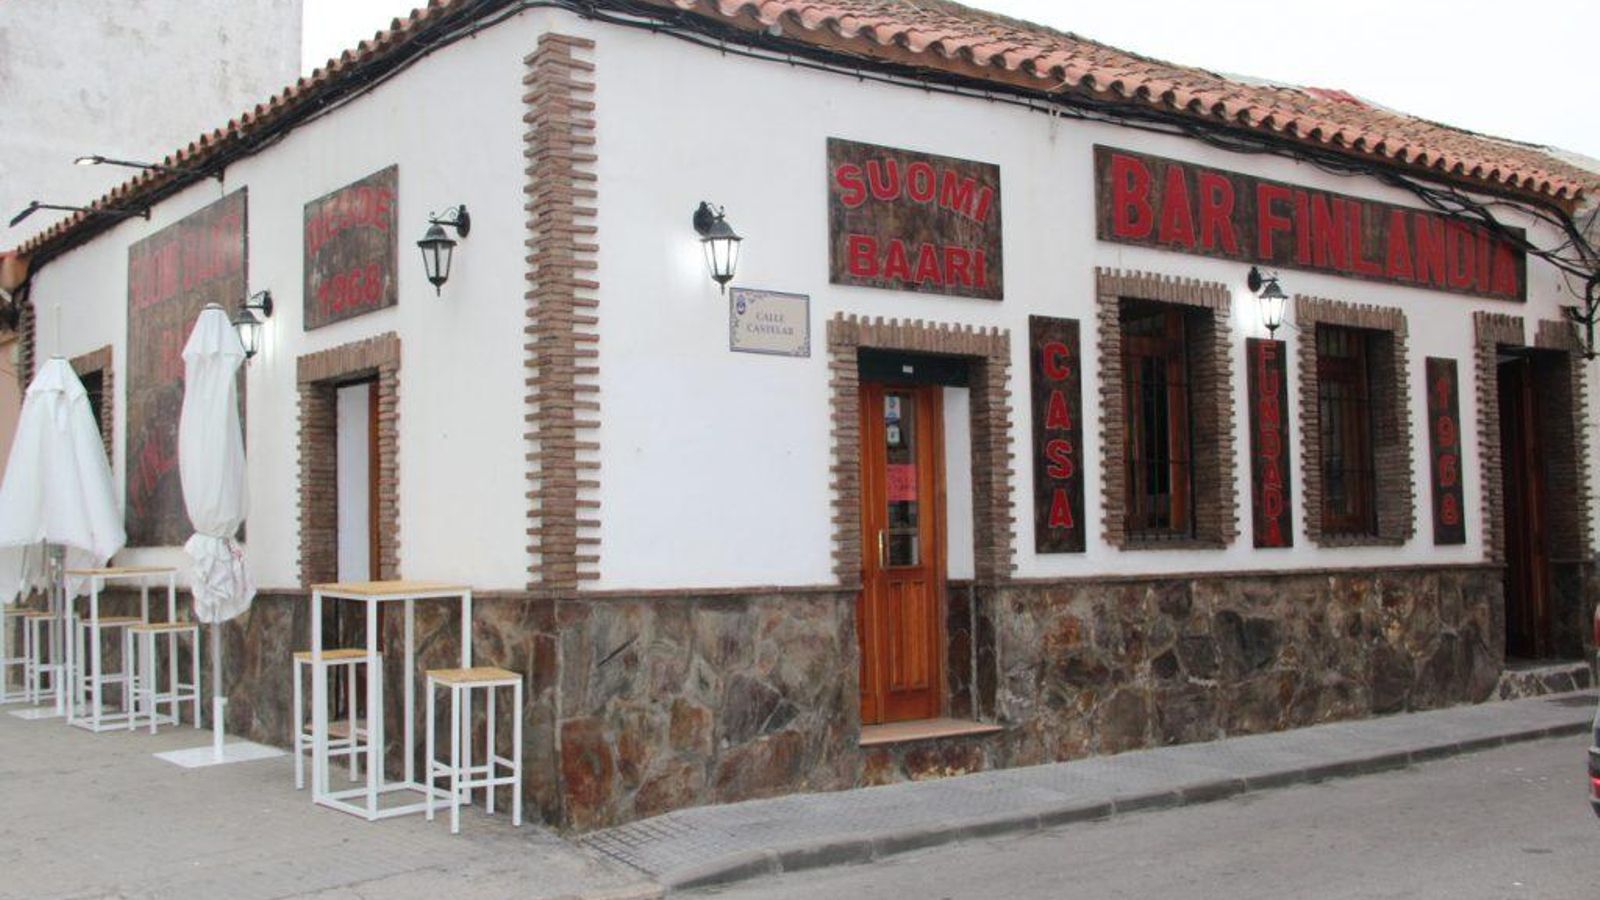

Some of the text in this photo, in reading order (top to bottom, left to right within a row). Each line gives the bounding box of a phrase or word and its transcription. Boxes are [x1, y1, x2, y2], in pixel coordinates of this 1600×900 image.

[835, 160, 994, 222] SUOMI
[1111, 154, 1518, 297] BAR FINLANDIA
[317, 262, 381, 317] 1968
[848, 233, 986, 288] BAARI
[755, 311, 784, 322] CALLE
[1042, 341, 1074, 529] CASA
[1258, 339, 1284, 545] FUNDADA
[1436, 377, 1458, 526] 1968
